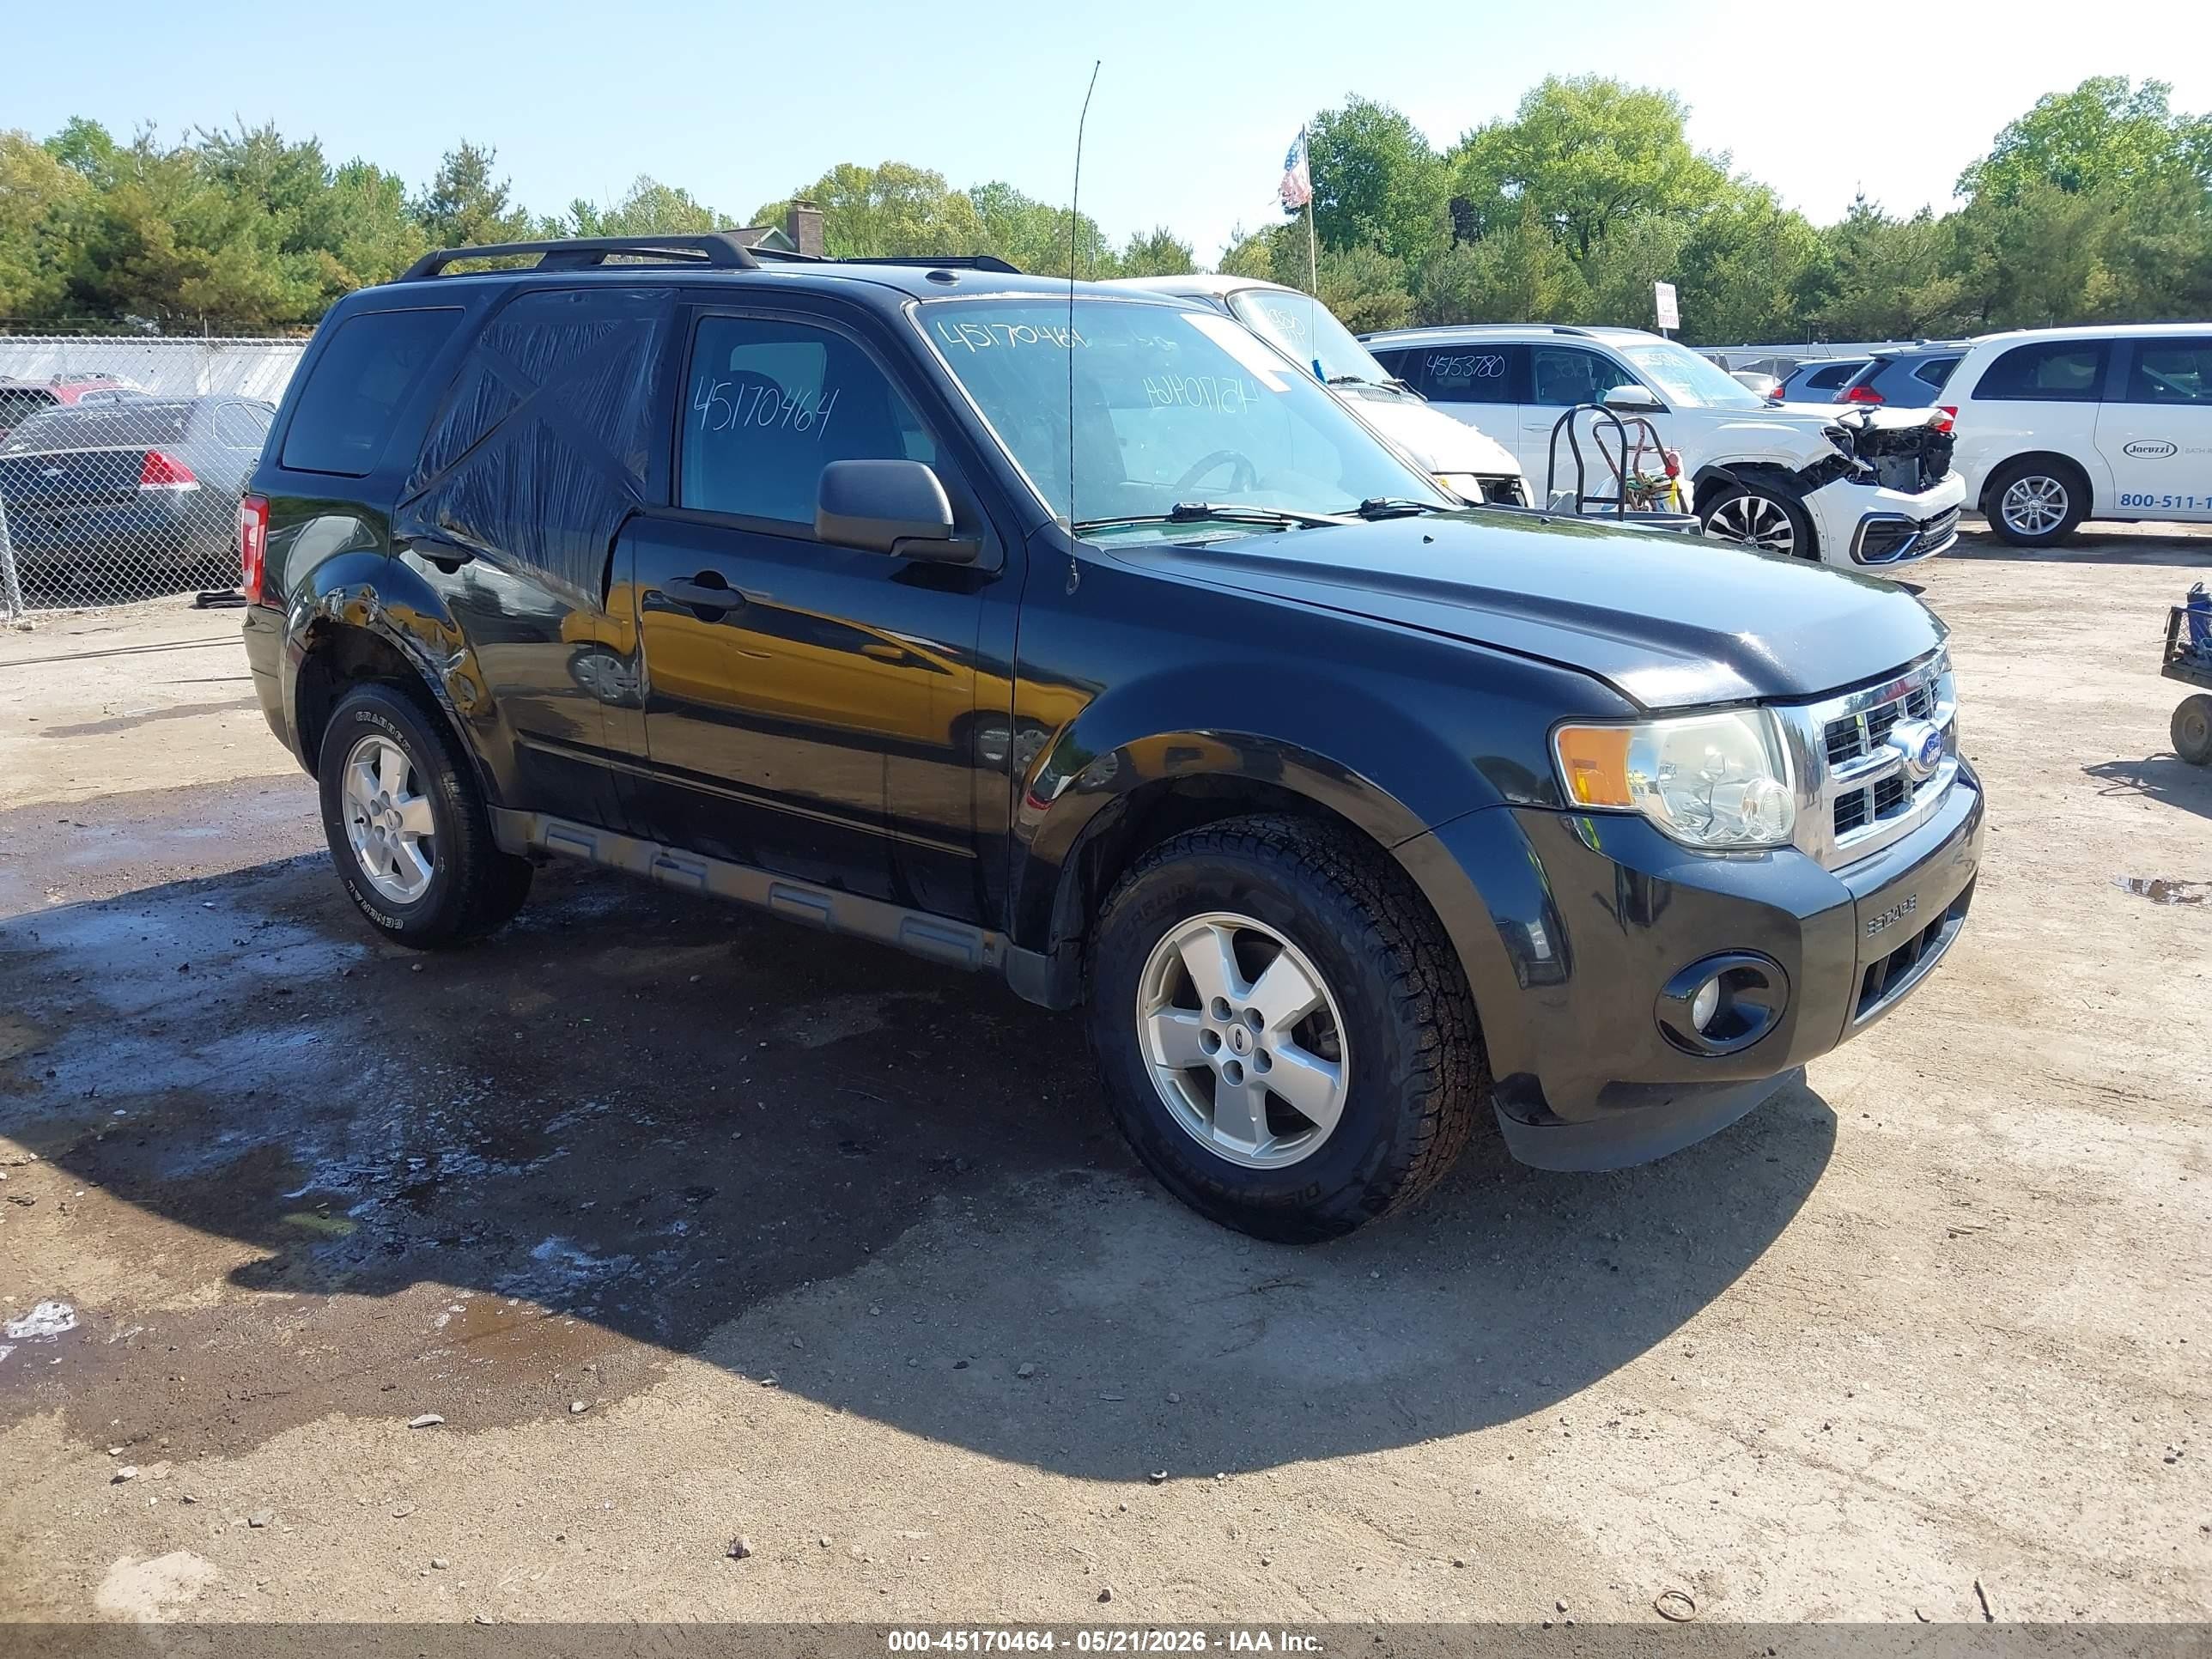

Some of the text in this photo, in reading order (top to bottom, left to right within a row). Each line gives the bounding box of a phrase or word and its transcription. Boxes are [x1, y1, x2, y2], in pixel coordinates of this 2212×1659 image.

[937, 321, 1089, 353] 45170464
[1426, 355, 1505, 378] 45153780
[694, 376, 841, 441] 45170464
[2129, 445, 2171, 453] Jacuzzi
[348, 879, 404, 930] GENERAL
[1866, 893, 1917, 939] ESCAPE
